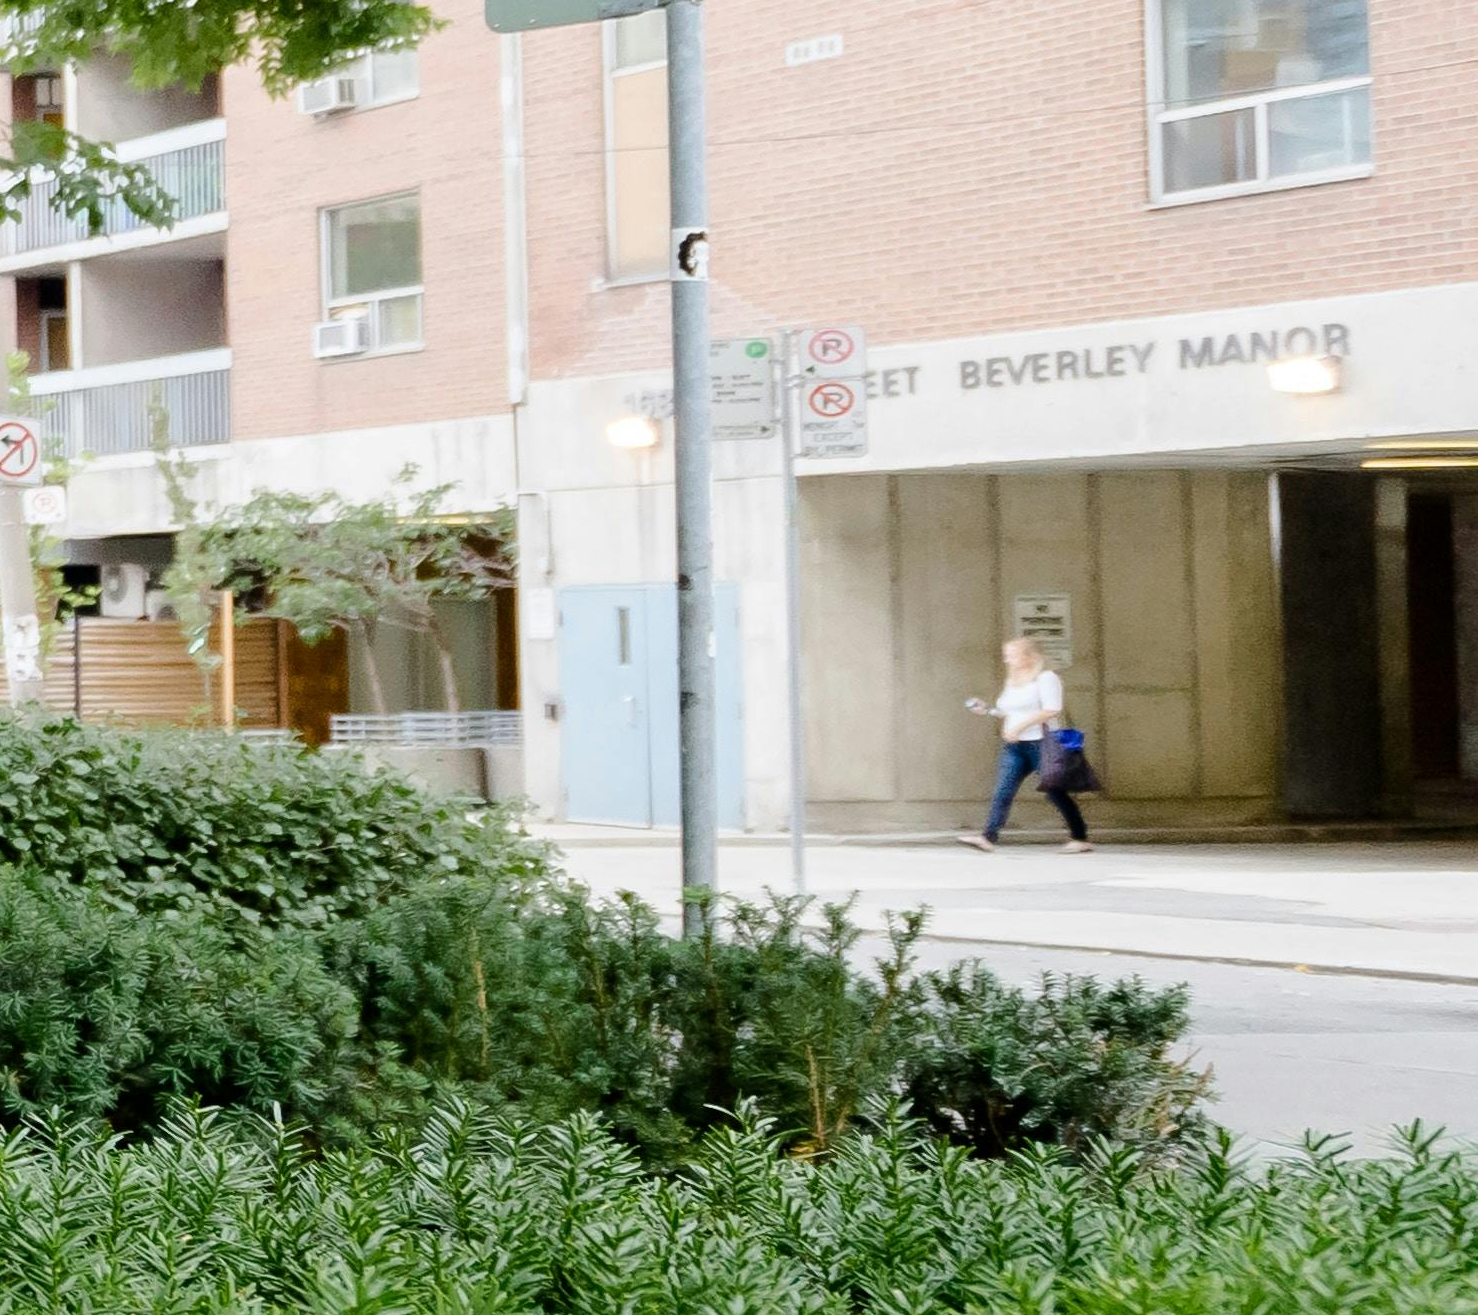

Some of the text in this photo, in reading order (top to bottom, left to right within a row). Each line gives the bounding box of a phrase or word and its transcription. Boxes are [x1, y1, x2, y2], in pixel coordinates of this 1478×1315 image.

[865, 323, 1350, 400] EET BEVERLEY MANOR
